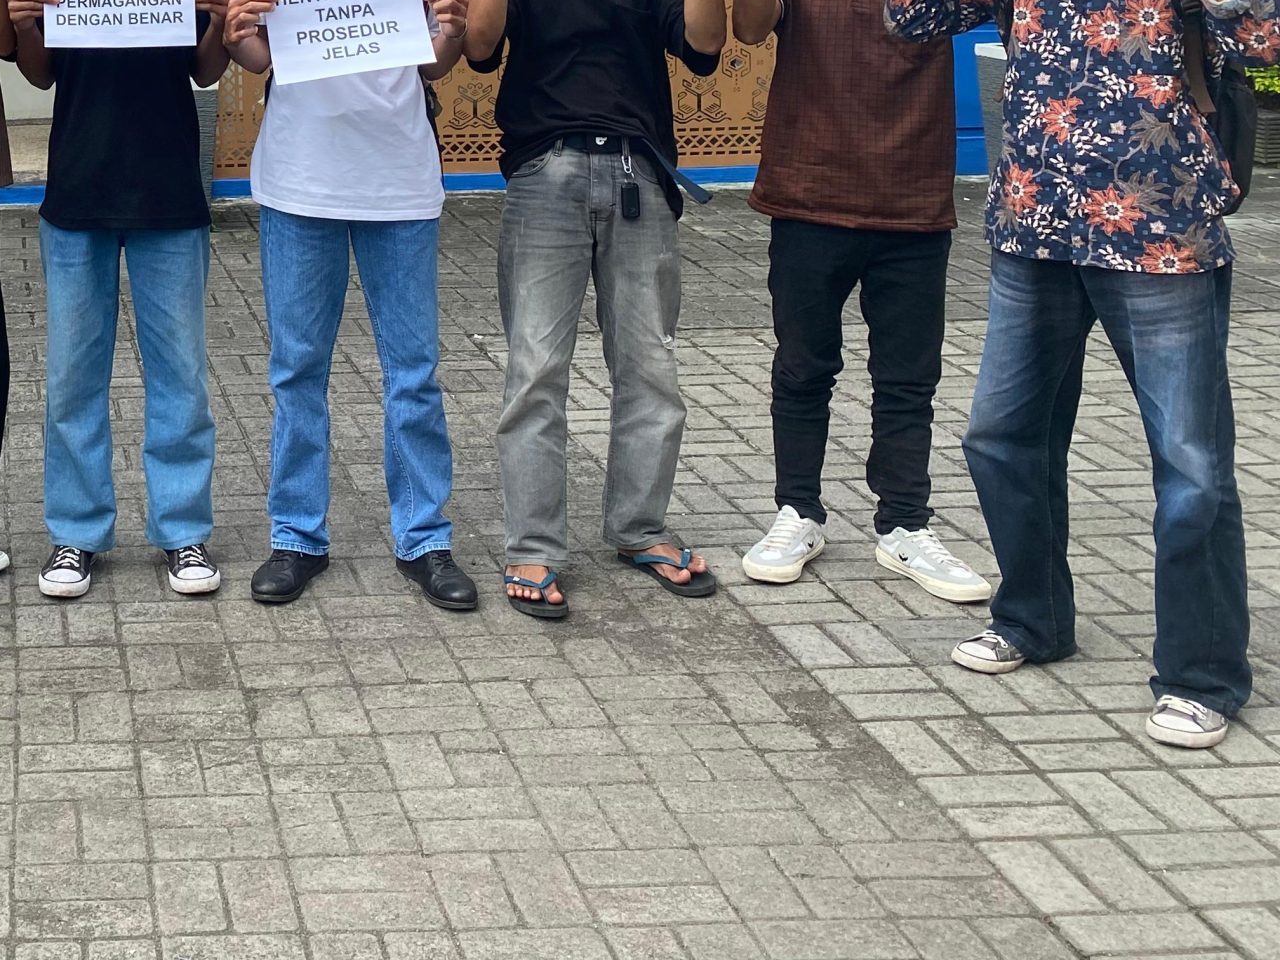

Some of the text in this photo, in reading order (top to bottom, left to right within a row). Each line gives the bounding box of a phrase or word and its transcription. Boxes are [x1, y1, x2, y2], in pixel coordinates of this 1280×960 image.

[56, 11, 183, 25] DENGAN BENAR
[315, 3, 375, 22] TANPA
[296, 20, 400, 45] PROSEDUR
[322, 42, 380, 60] JELAS
